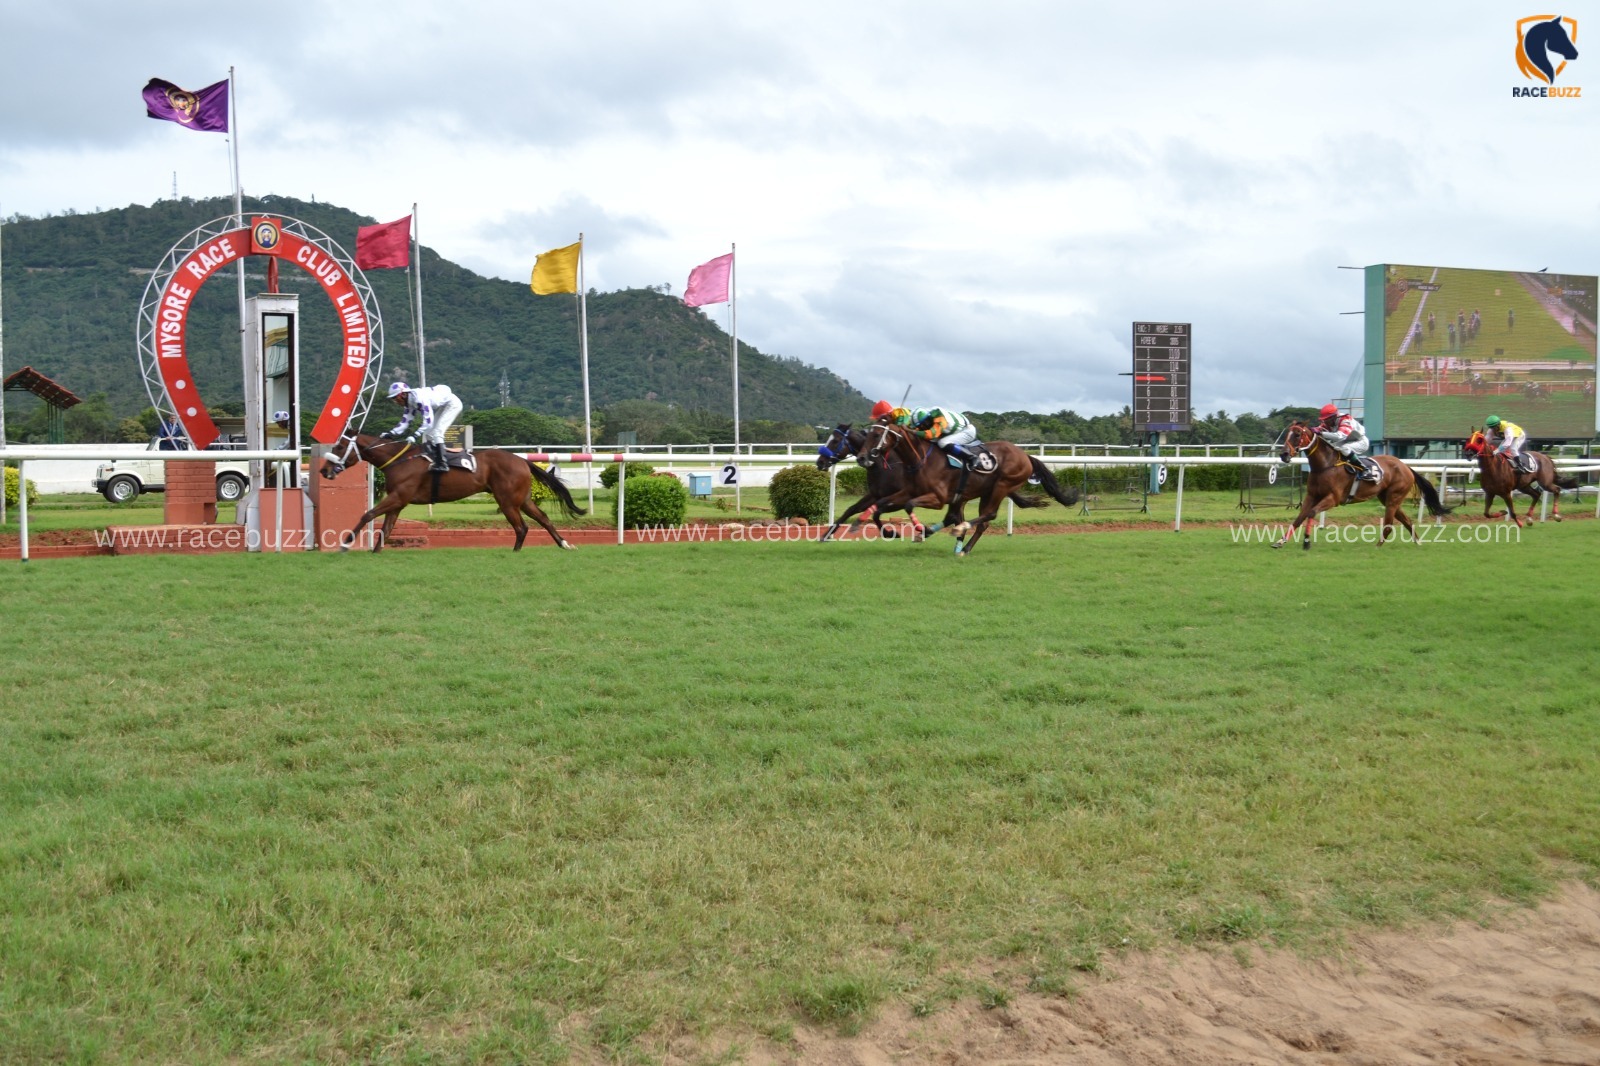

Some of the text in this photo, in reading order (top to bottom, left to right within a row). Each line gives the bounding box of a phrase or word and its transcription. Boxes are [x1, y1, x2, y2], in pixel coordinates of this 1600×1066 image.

[160, 238, 366, 369] MYSORE RACE CLUB LIMITED
[979, 452, 993, 470] 8
[723, 466, 737, 485] 2
[1159, 467, 1165, 483] 5
[1270, 466, 1276, 483] 6
[1371, 465, 1381, 482] 5
